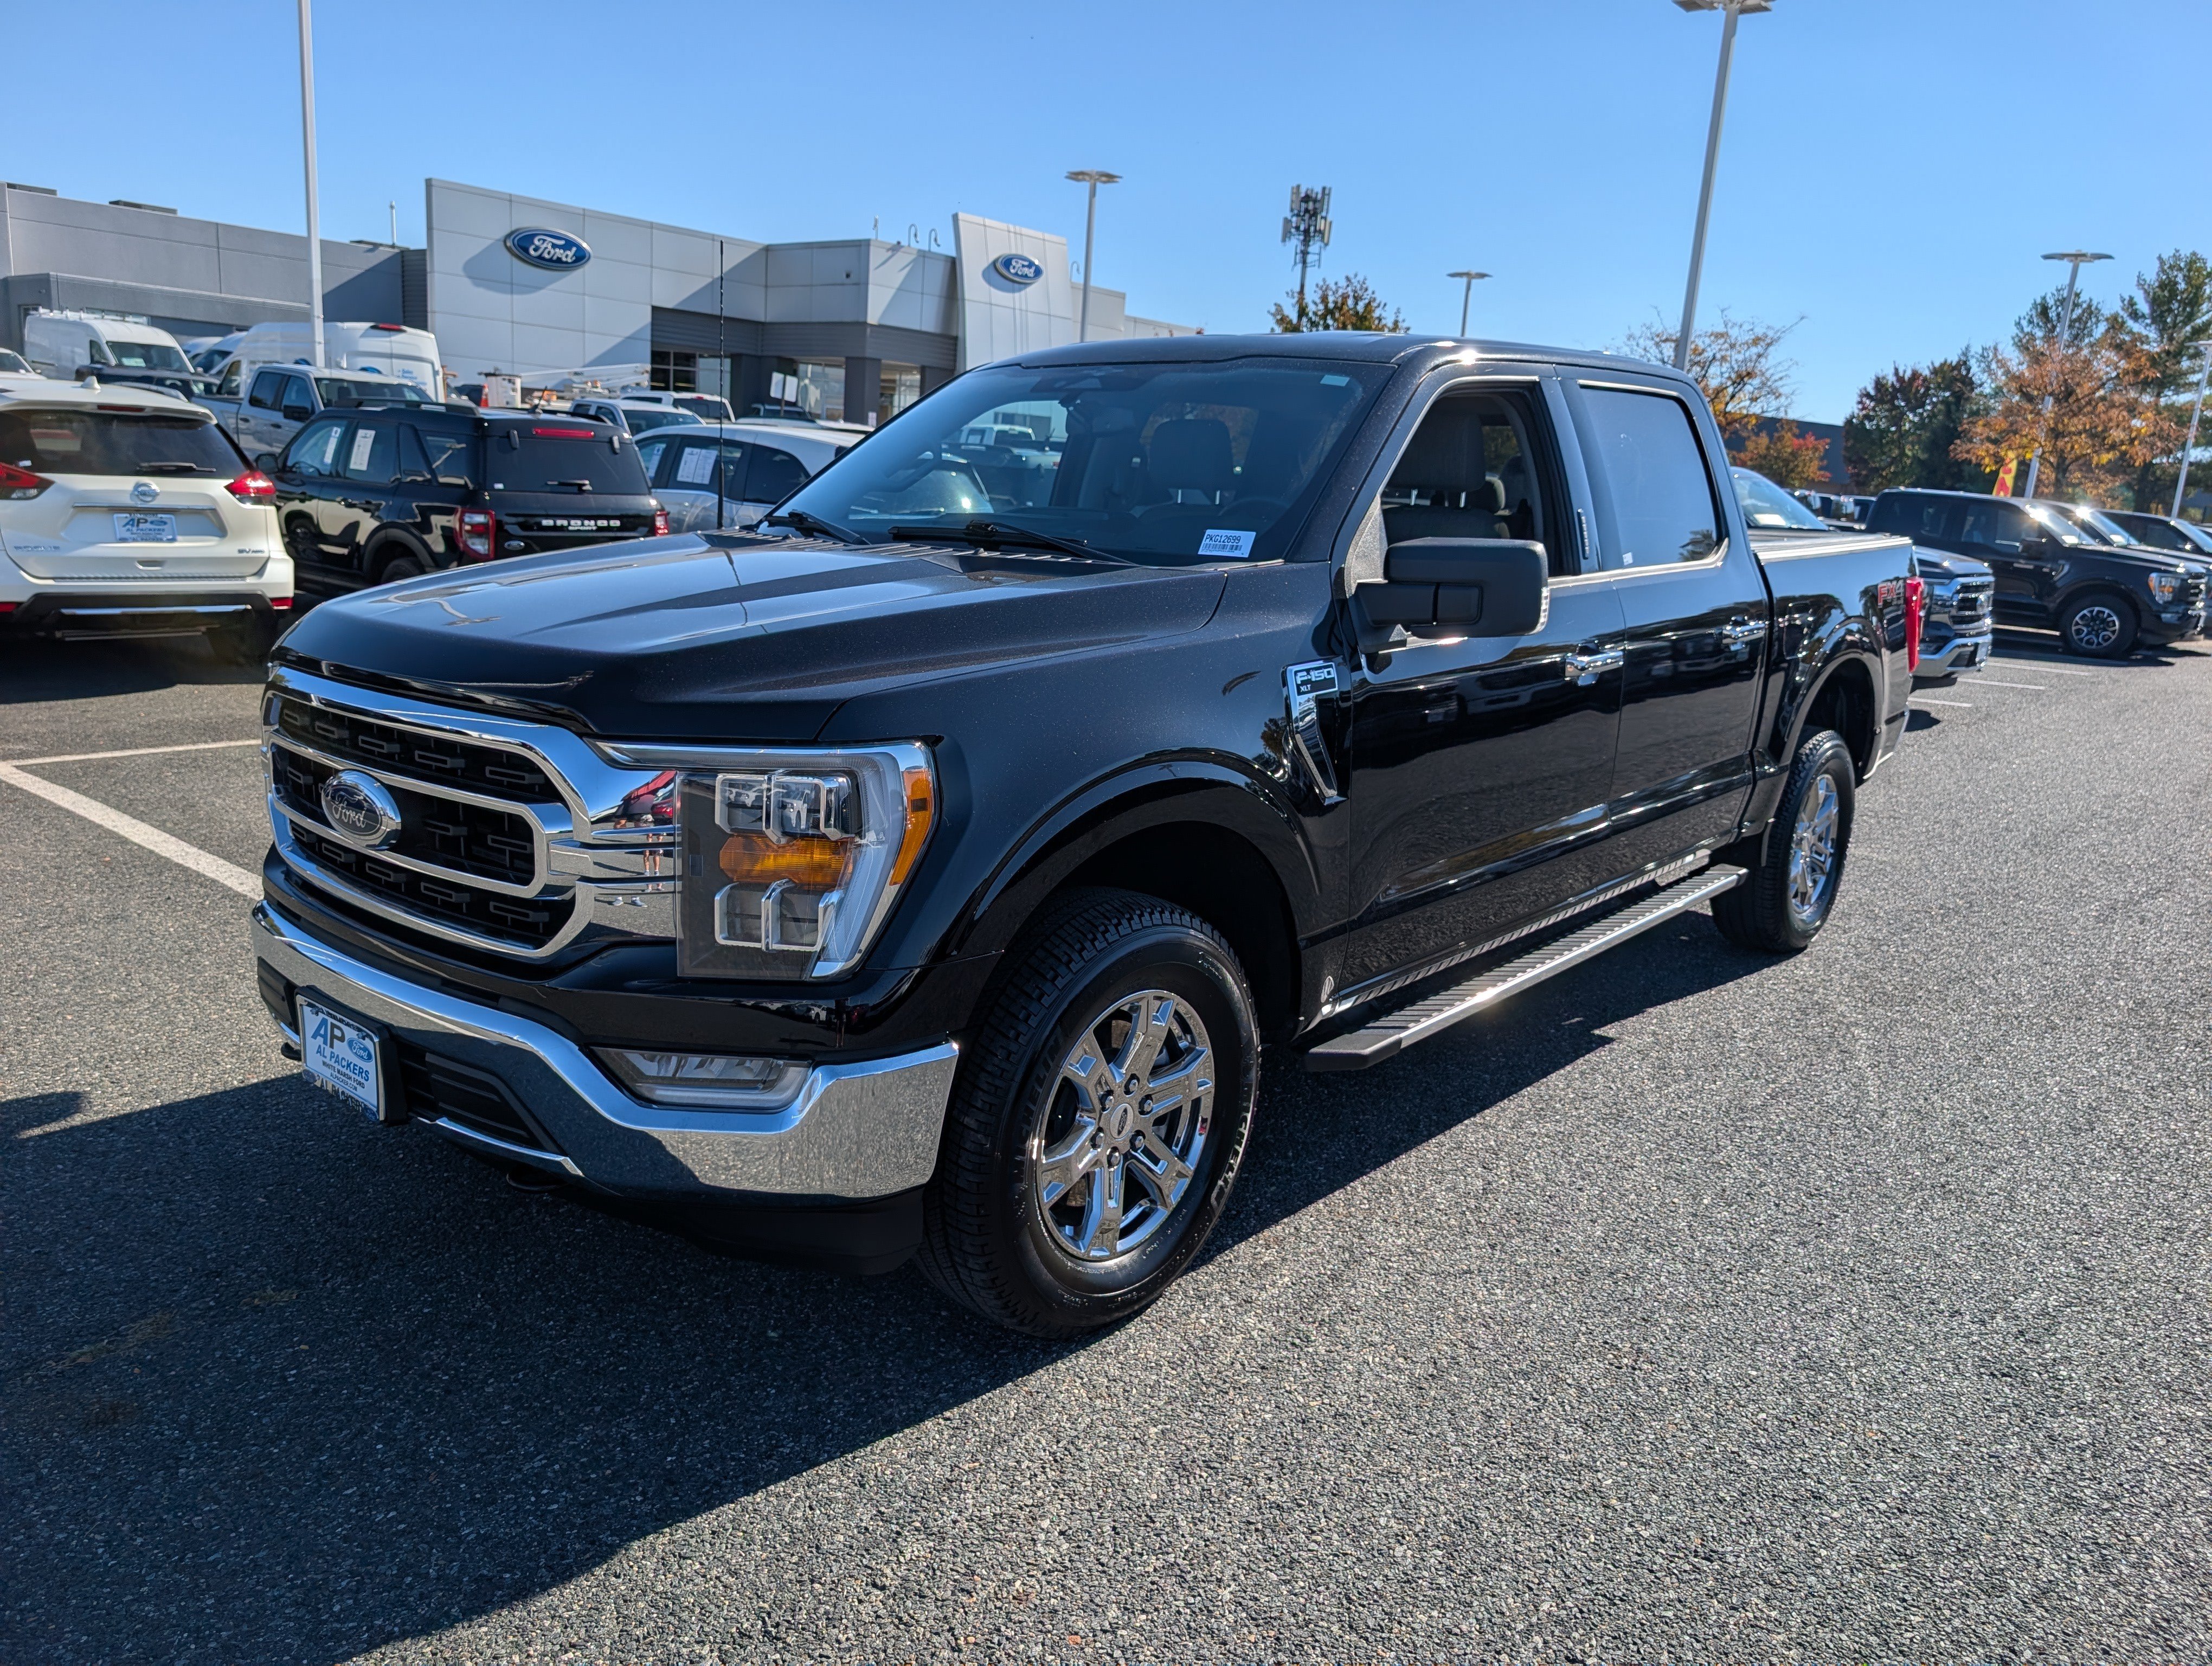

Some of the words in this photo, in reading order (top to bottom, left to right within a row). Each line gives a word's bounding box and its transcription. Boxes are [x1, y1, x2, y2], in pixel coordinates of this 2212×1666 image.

[529, 235, 577, 262] Ford
[1009, 258, 1036, 278] Ford
[1204, 534, 1242, 544] PKG12699
[1877, 579, 1904, 608] FX4
[1300, 684, 1311, 693] XLT
[332, 791, 366, 828] Ford
[311, 1017, 345, 1049] AP
[316, 1044, 327, 1058] AL
[330, 1050, 370, 1082] PACKERS
[351, 1040, 369, 1060] Ford
[322, 1060, 336, 1072] WHITE
[337, 1068, 352, 1082] MARSH
[353, 1077, 365, 1089] FORD
